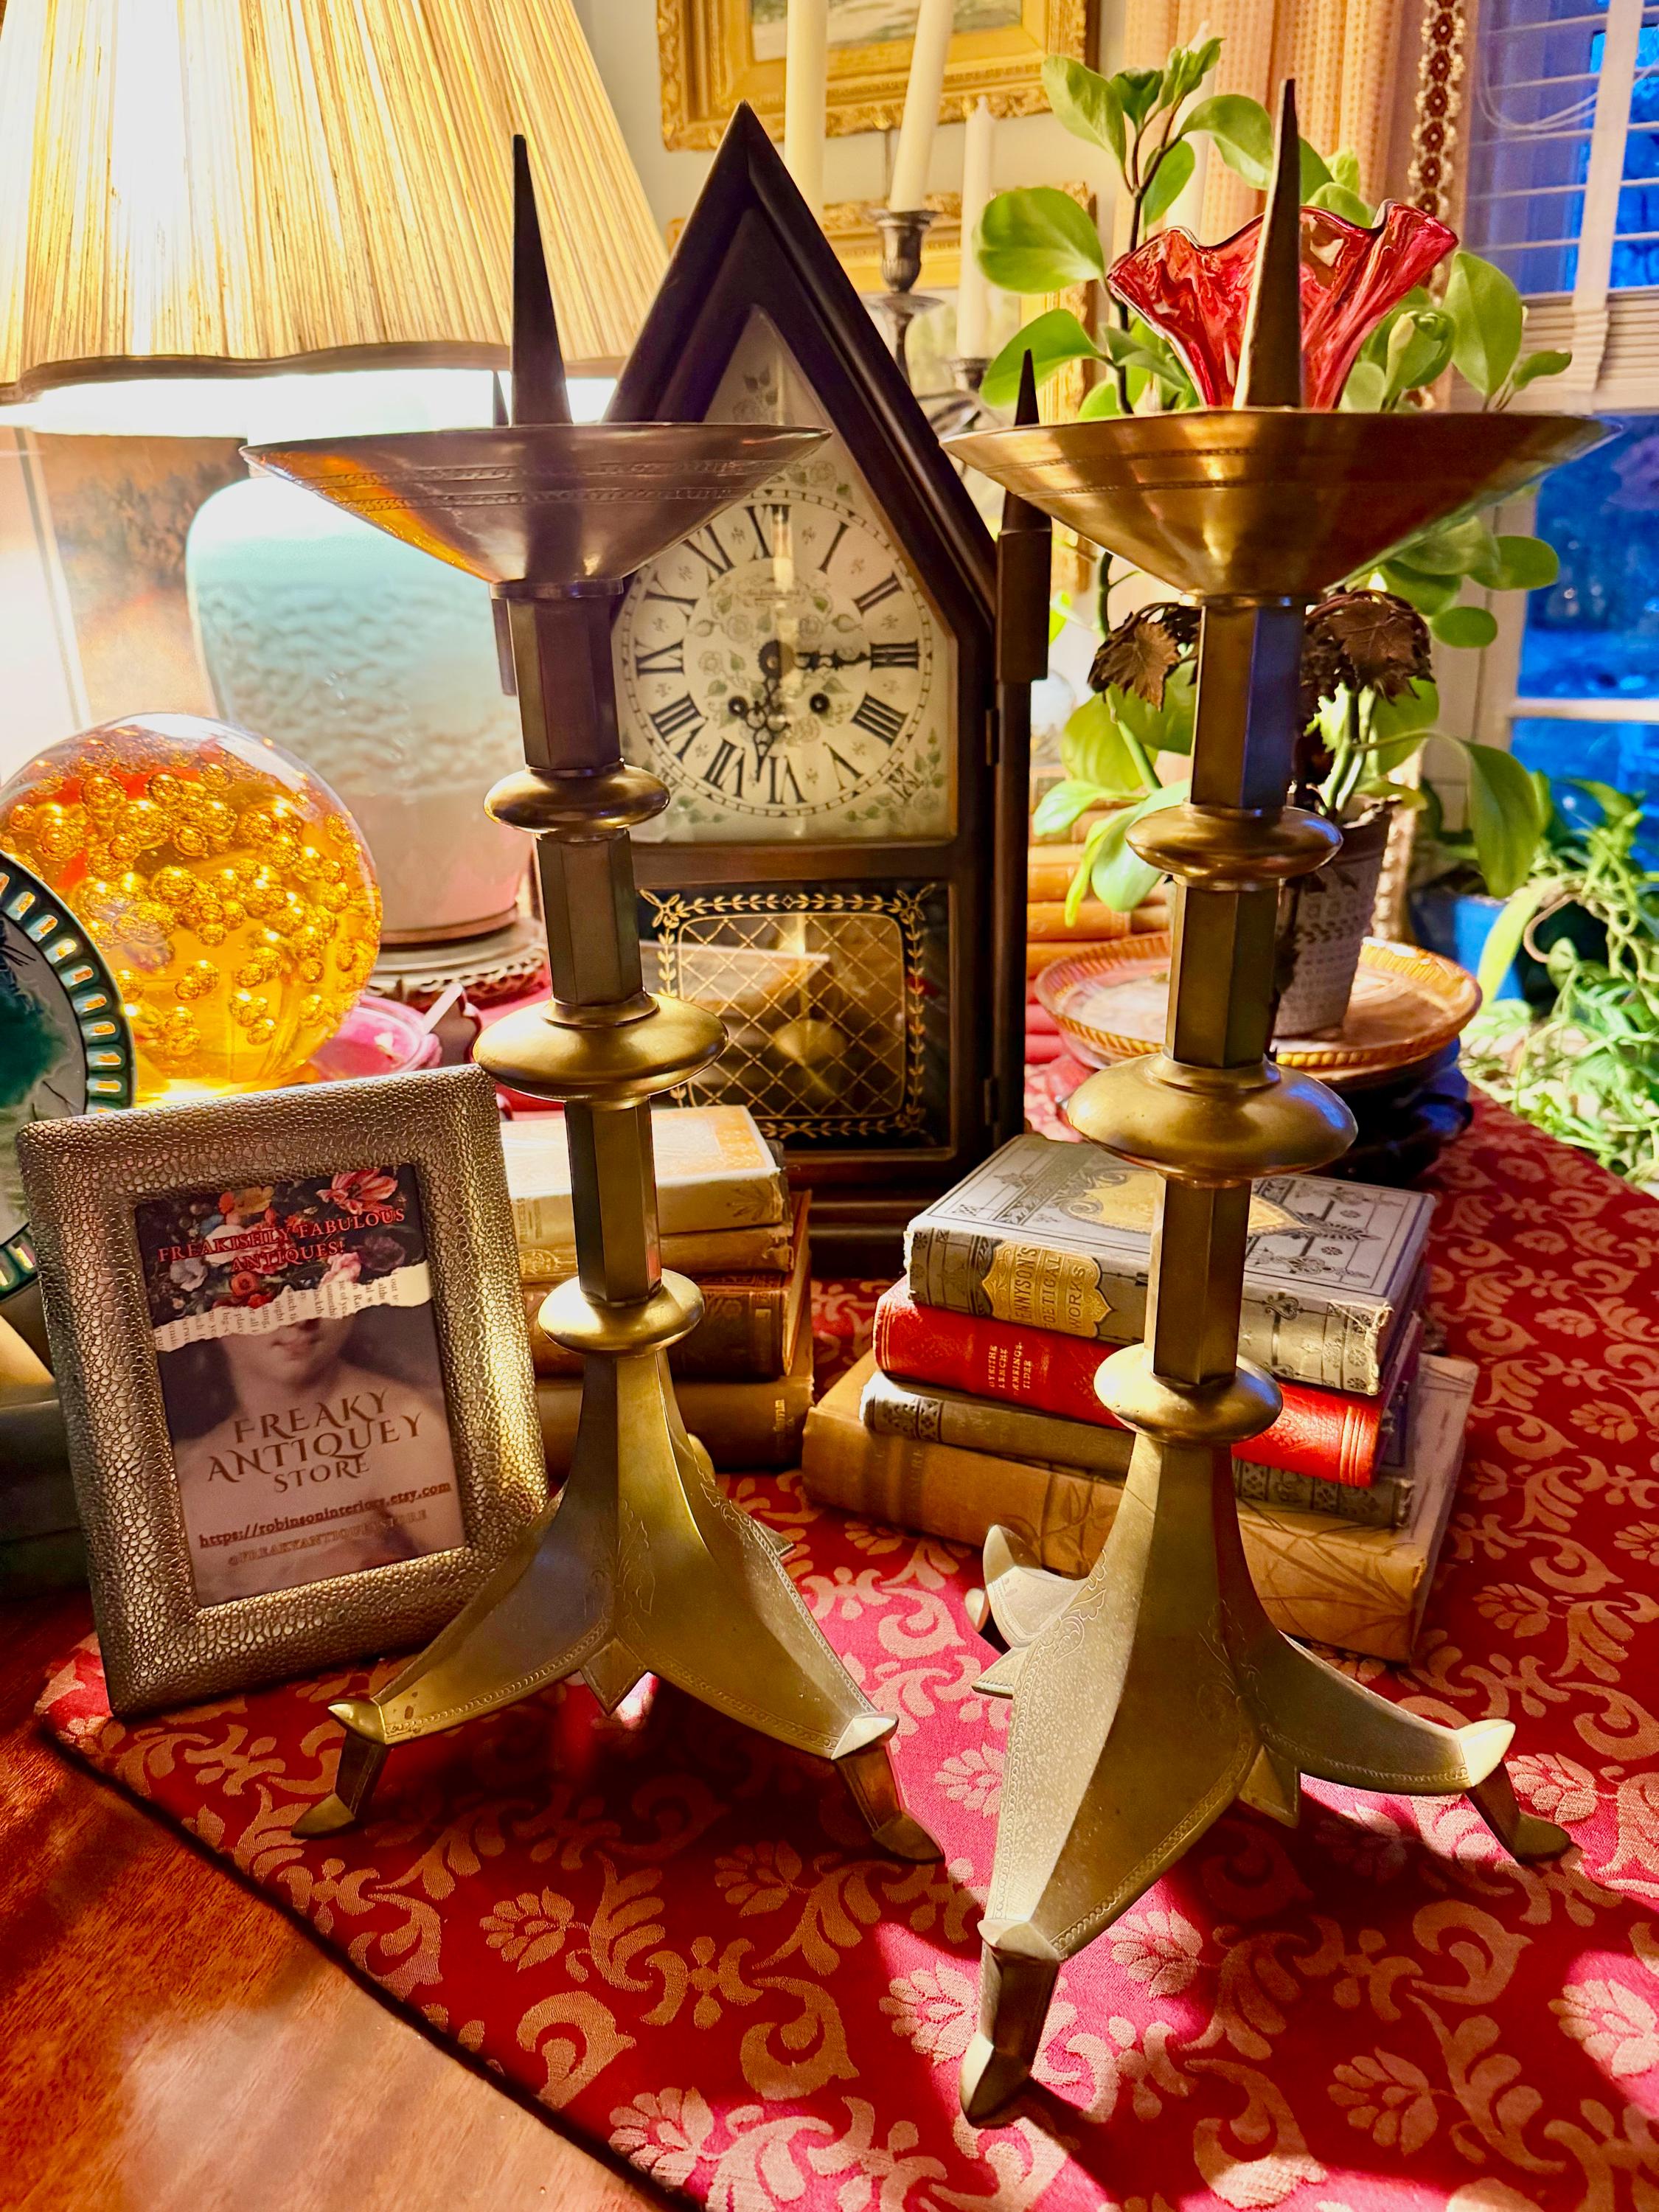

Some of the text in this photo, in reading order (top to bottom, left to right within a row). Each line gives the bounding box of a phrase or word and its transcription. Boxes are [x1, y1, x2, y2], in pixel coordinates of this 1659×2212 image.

[157, 1207, 406, 1263] FREAKISHLY FABULOUS
[231, 1239, 346, 1273] ANTIQUES!
[1043, 1254, 1062, 1329] POETICAL
[1068, 1265, 1087, 1330] WORKS
[234, 1388, 388, 1444] FREAKY
[207, 1411, 422, 1483] ANTIQUEY
[274, 1457, 369, 1493] STORE
